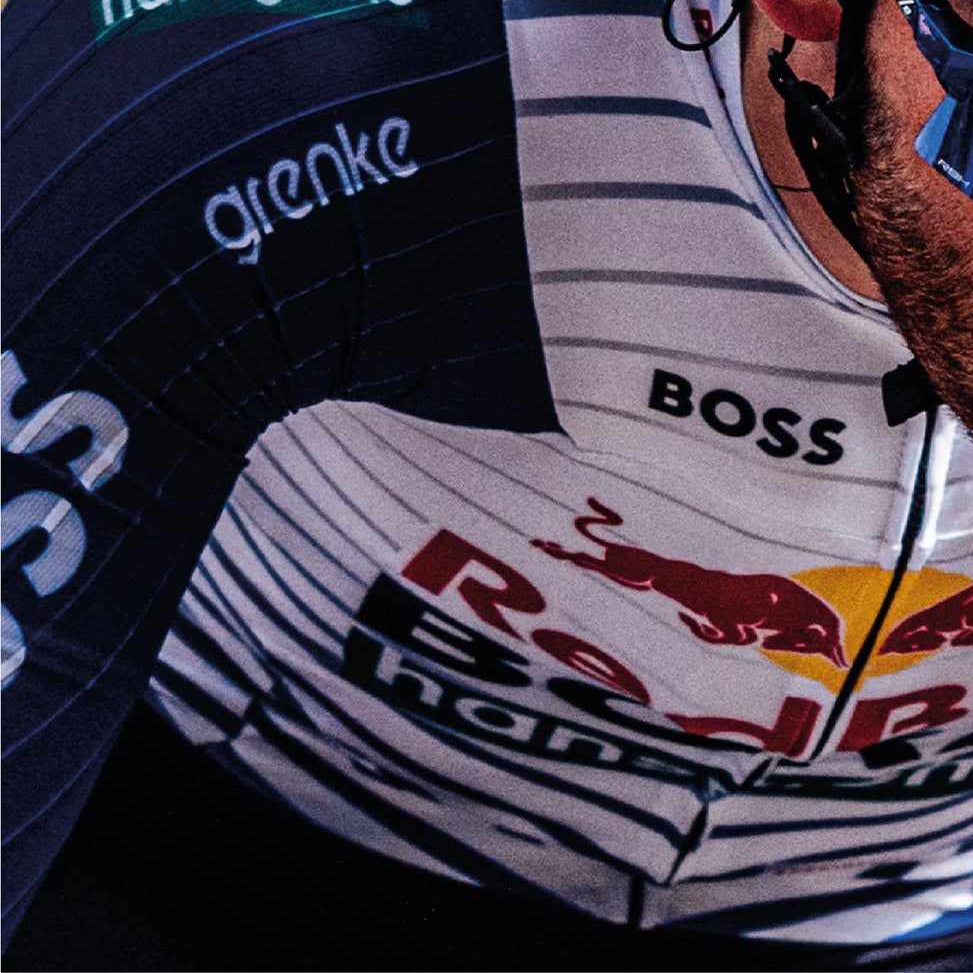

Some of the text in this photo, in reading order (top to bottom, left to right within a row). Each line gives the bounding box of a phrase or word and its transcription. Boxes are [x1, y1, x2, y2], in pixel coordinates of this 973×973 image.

[204, 117, 420, 265] grenke
[648, 368, 847, 466] BOSS
[401, 528, 822, 759] Red
